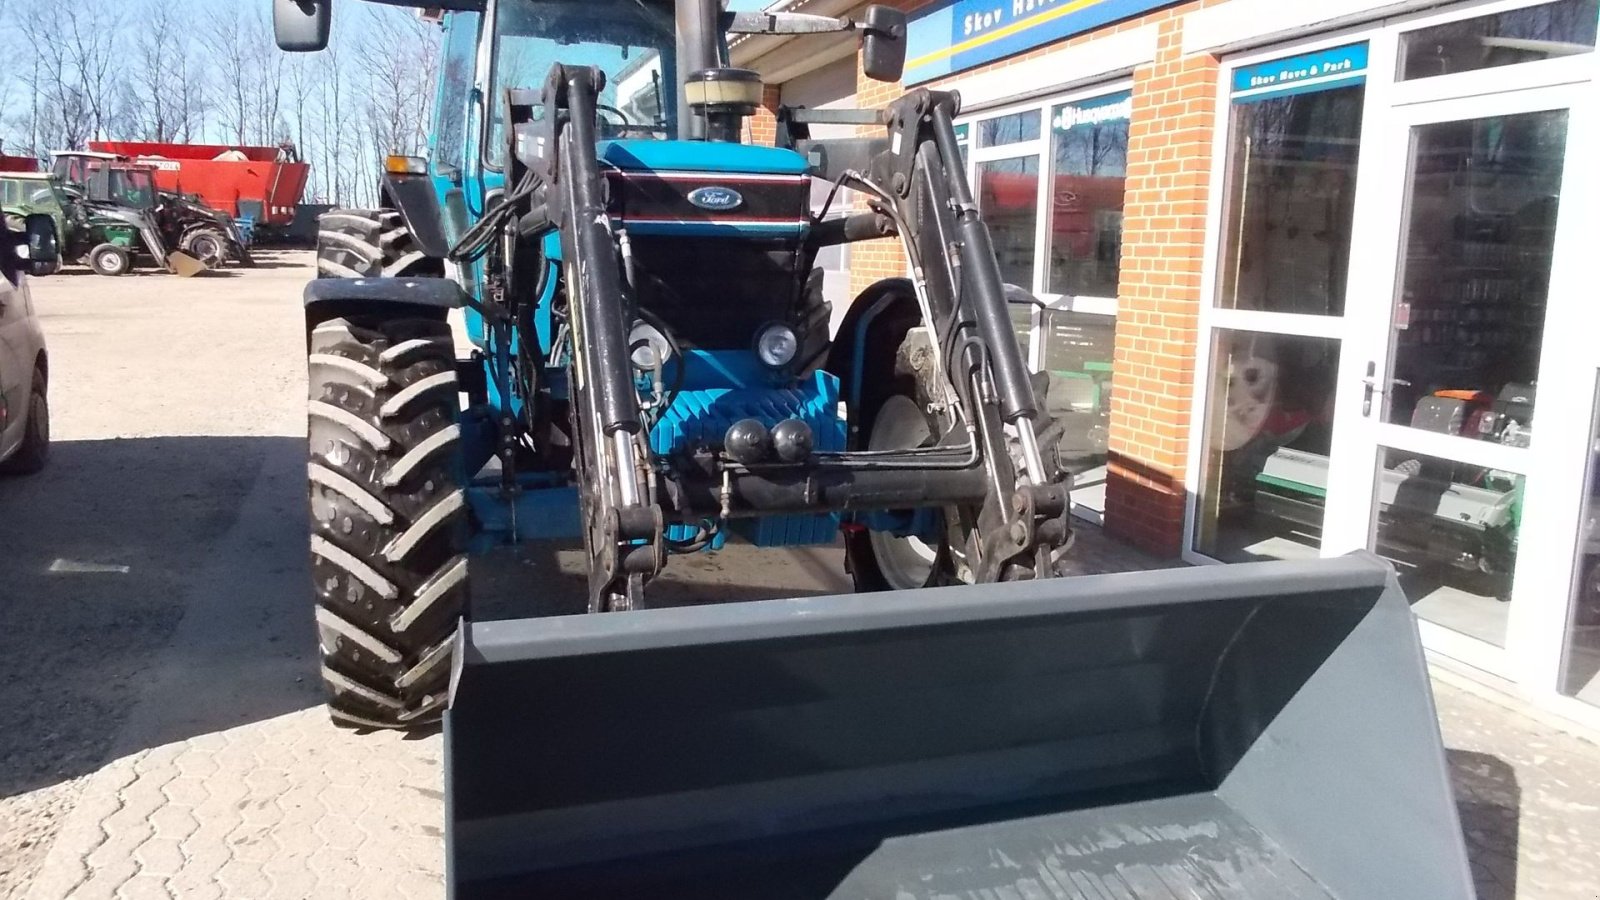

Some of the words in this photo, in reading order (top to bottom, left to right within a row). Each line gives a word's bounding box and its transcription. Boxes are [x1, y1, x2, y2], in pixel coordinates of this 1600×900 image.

[964, 8, 1002, 36] Skov
[1012, 0, 1056, 17] Ha
[1250, 75, 1276, 87] Skov
[1279, 69, 1308, 81] Have
[1309, 64, 1319, 76] &
[1322, 58, 1352, 73] Park
[701, 191, 730, 205] Ford
